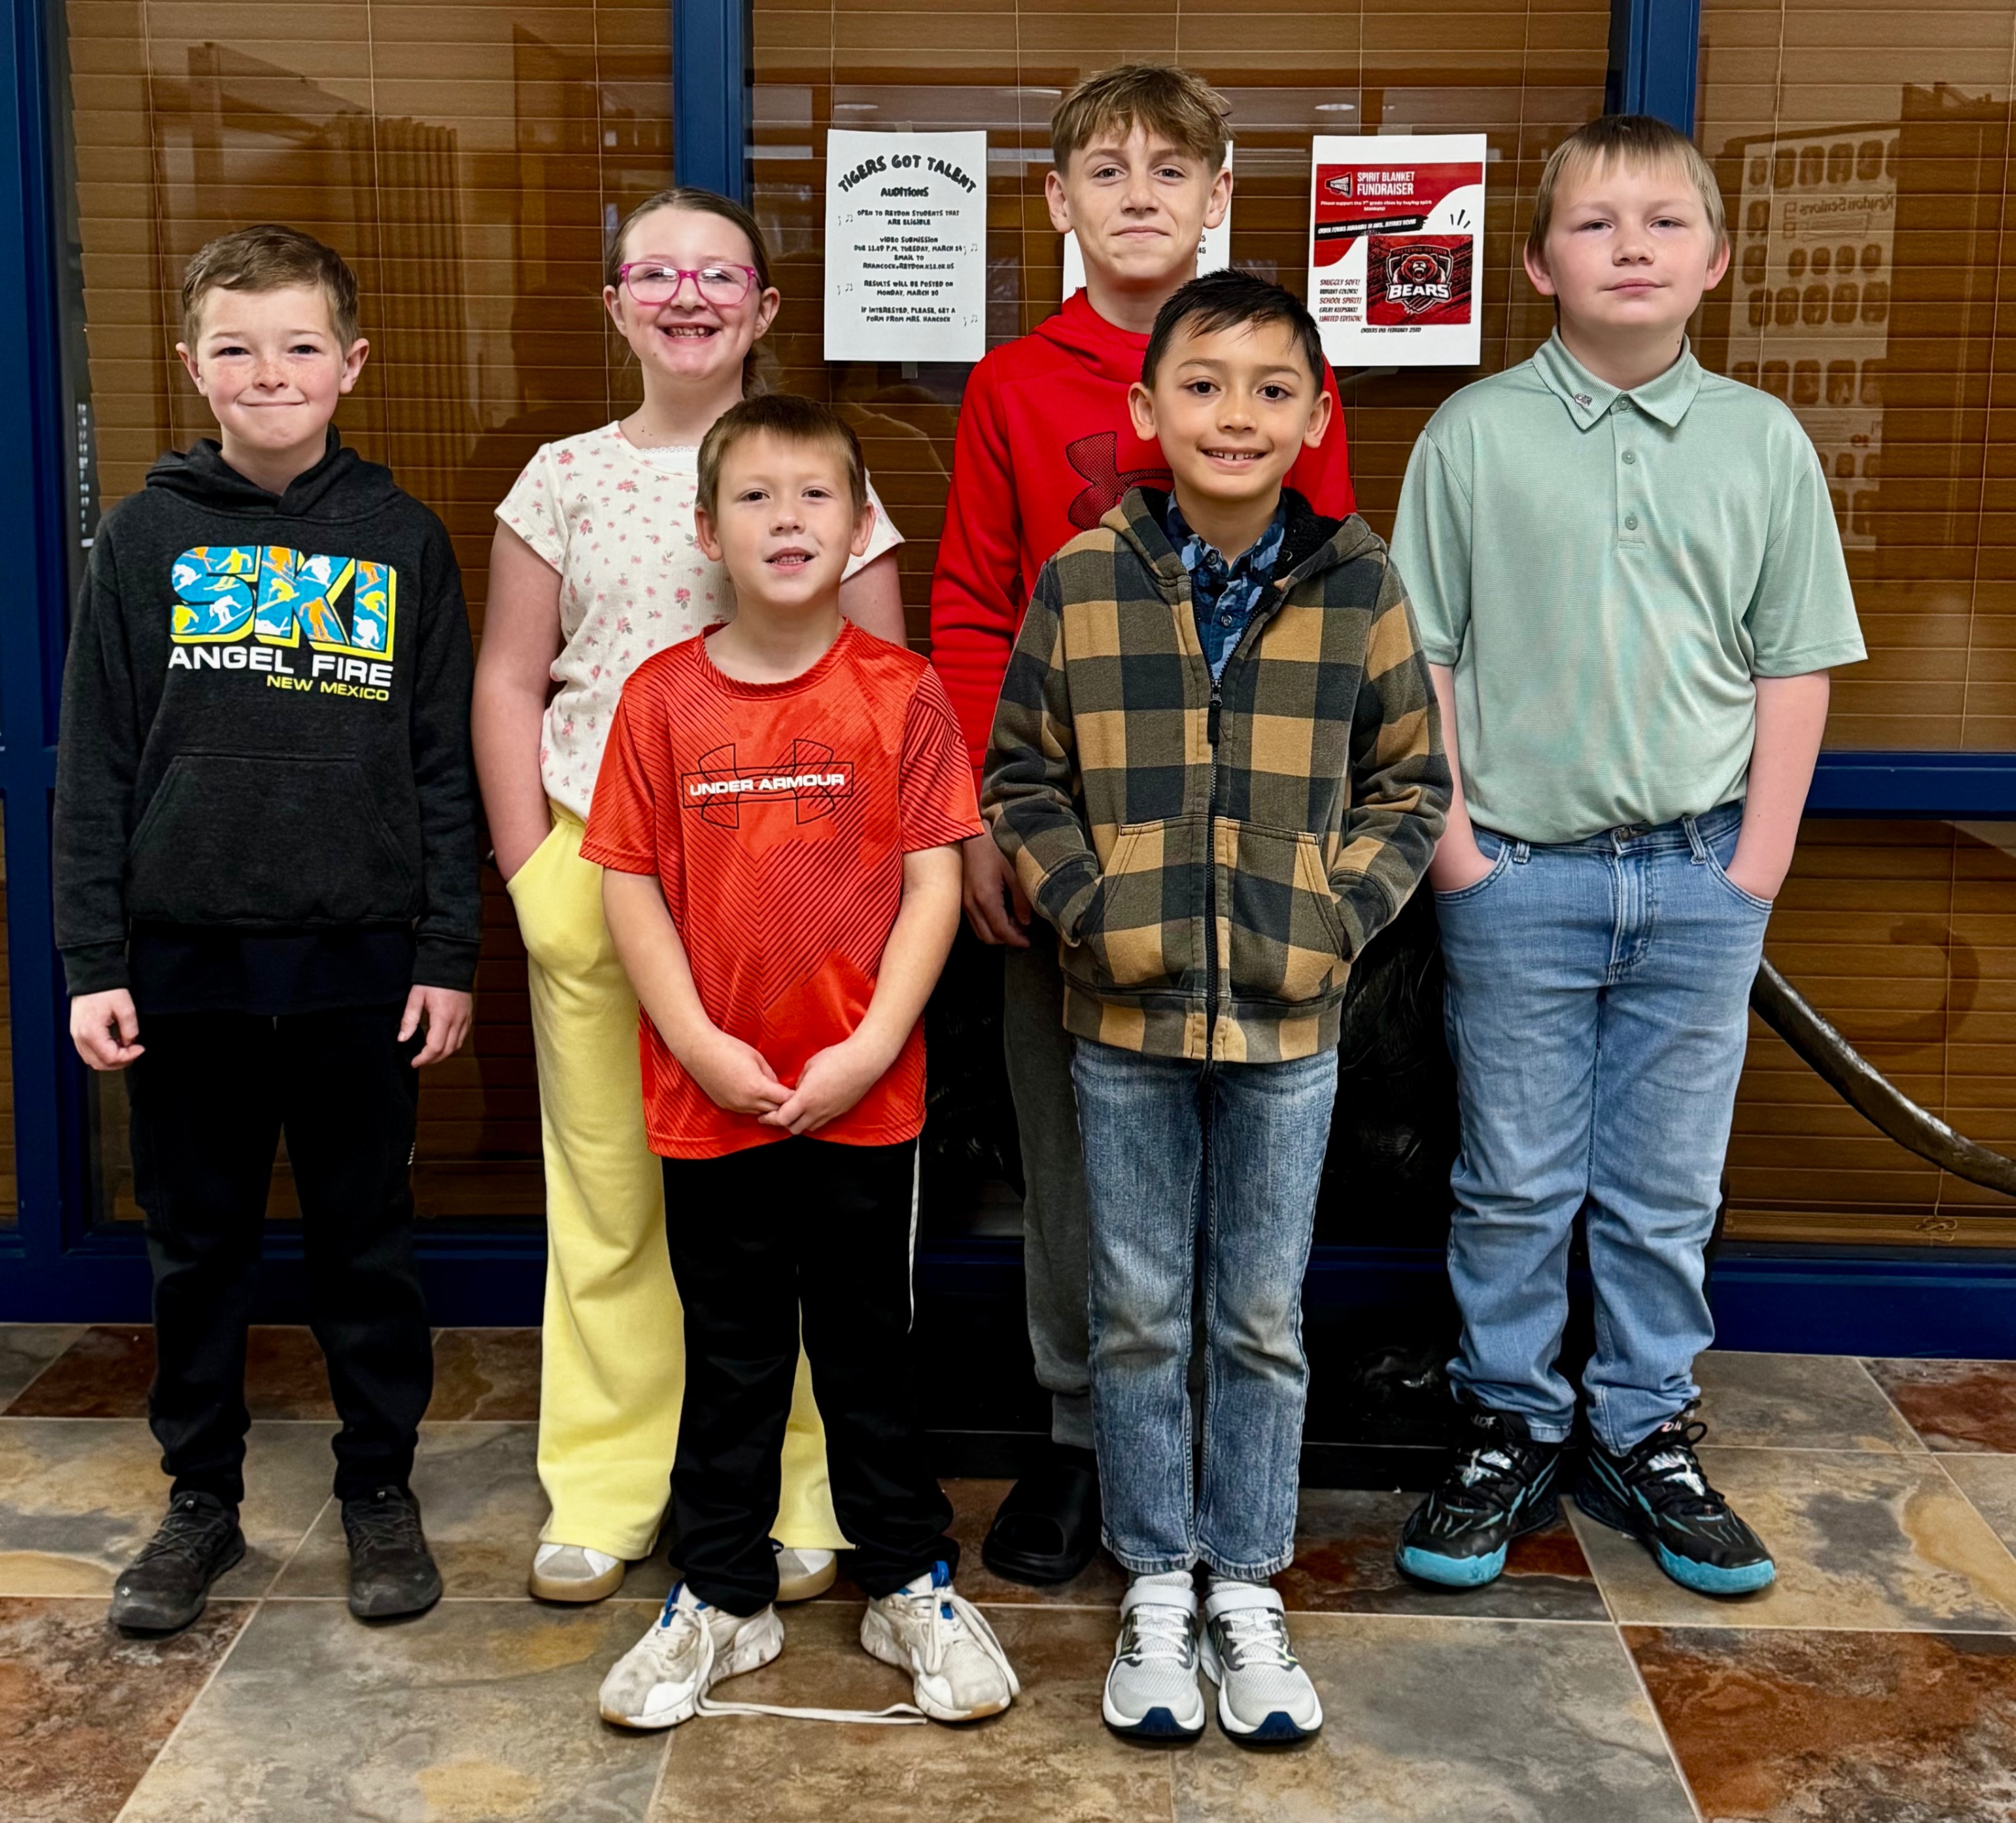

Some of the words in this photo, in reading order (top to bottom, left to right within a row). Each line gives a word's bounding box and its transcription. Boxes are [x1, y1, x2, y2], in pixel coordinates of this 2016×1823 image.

[838, 155, 887, 192] TIGERS
[892, 154, 921, 169] GOT
[927, 157, 976, 193] TALENT
[1357, 172, 1379, 182] SPIRIT
[1382, 172, 1415, 181] BLANKET
[881, 187, 929, 197] AUDITIONS
[1357, 183, 1414, 195] FUNDRAISER
[1389, 284, 1449, 299] BEARS
[170, 546, 397, 662] SKI
[168, 646, 294, 674] ANGEL
[312, 654, 393, 687] FIRE
[267, 675, 313, 691] NEW
[321, 681, 389, 701] MEXICO
[690, 779, 754, 796] UNDER
[758, 774, 844, 790] ARMOUR
